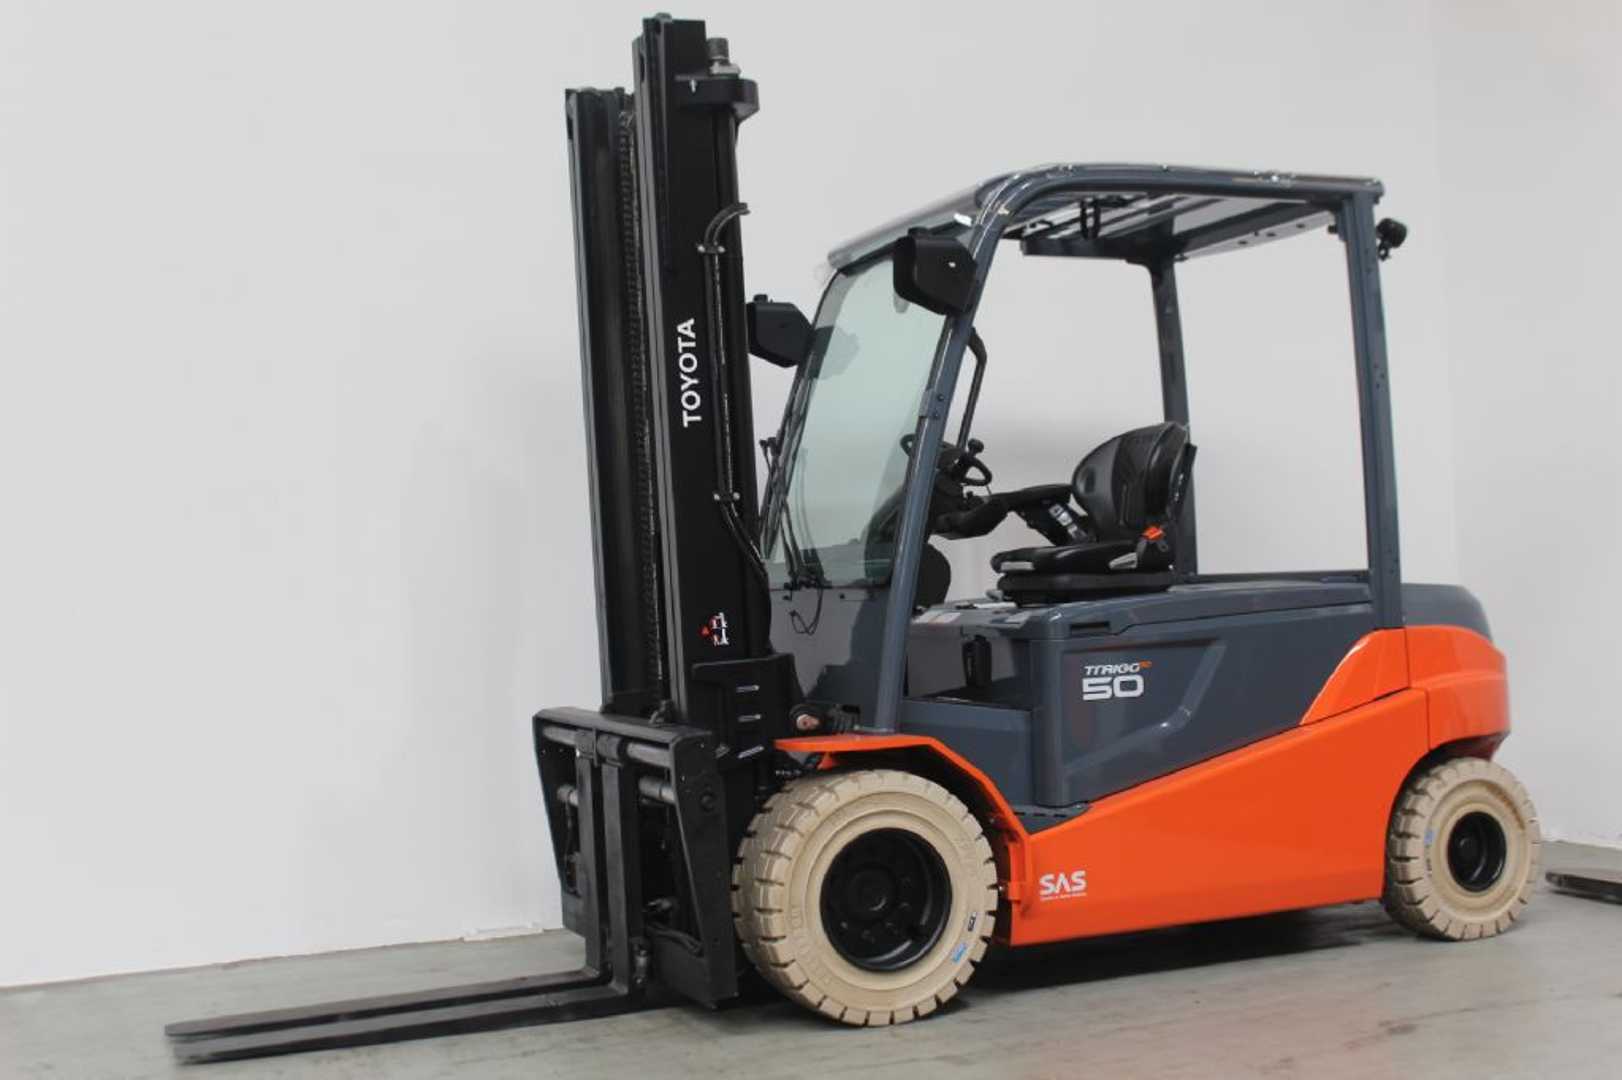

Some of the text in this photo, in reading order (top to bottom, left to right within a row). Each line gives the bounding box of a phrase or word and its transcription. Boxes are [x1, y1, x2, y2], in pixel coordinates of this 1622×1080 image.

[677, 318, 702, 427] TOYOTA
[1082, 674, 1144, 700] 50
[1040, 870, 1087, 896] SAS
